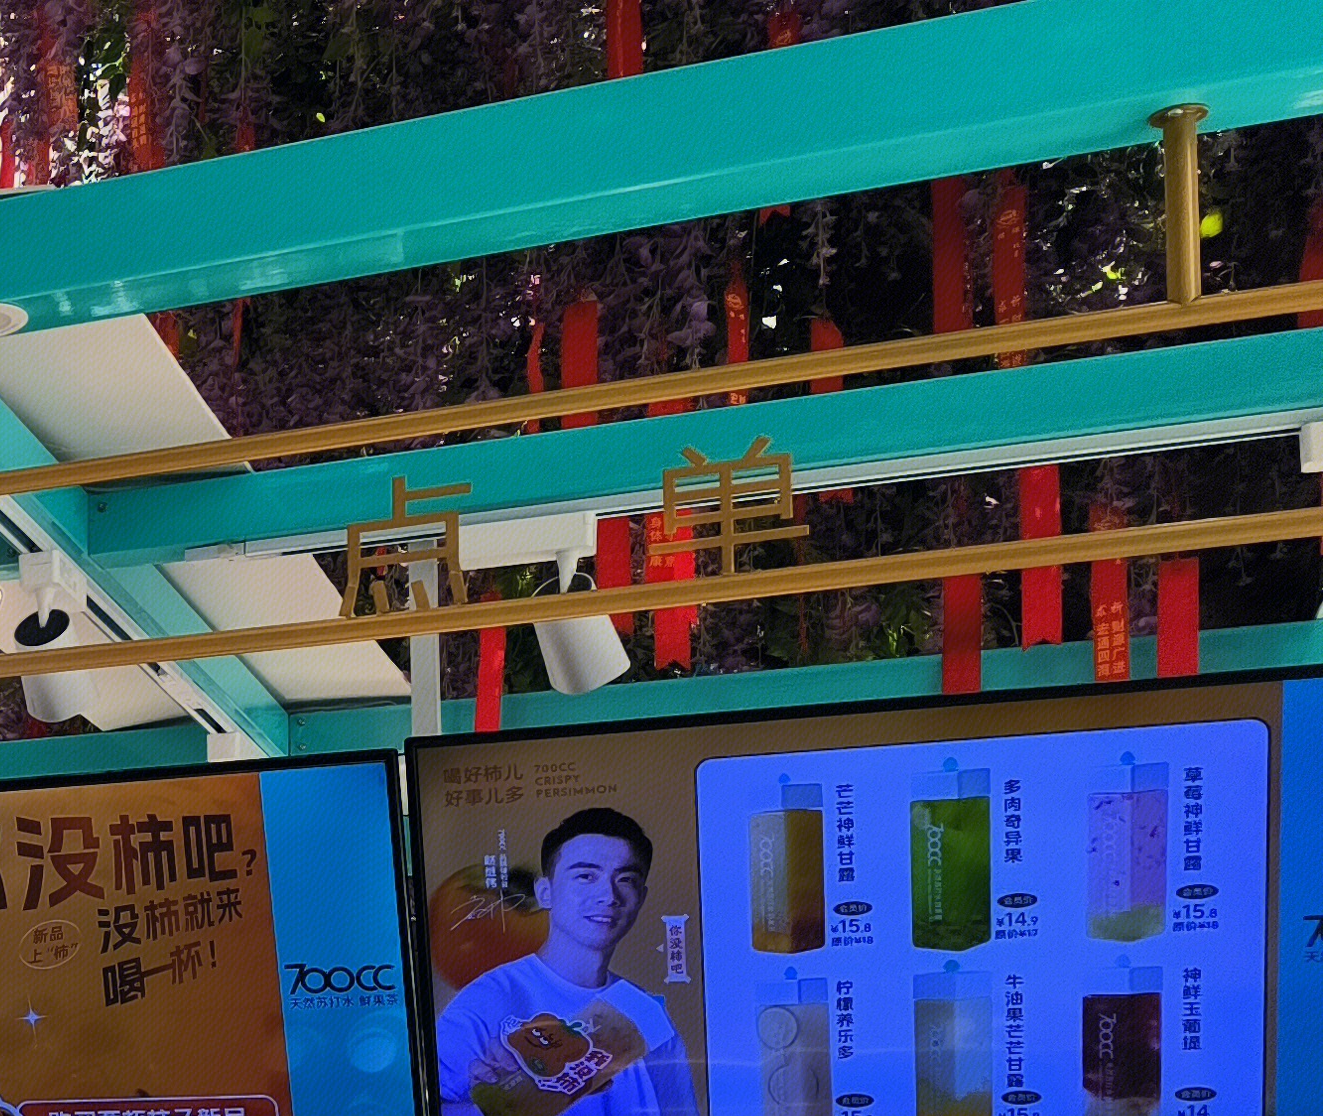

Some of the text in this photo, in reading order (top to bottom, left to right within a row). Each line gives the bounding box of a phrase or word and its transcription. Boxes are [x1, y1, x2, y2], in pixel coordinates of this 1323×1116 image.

[443, 762, 523, 785] 喝好柿儿
[533, 761, 577, 774] 700CC
[534, 774, 580, 787] CRISPY
[535, 784, 618, 799] PERSIMMON
[444, 786, 524, 808] 好事儿多
[1003, 778, 1023, 864] 多肉奇异果
[97, 886, 245, 956] 没柿就来
[996, 911, 1039, 928] ¥14.9
[31, 925, 64, 943] 新品
[104, 944, 219, 1008] 喝一杯!
[284, 963, 396, 996] 700CC
[289, 994, 354, 1010] 天然苏打水
[836, 979, 855, 1061] 柠檬养乐多
